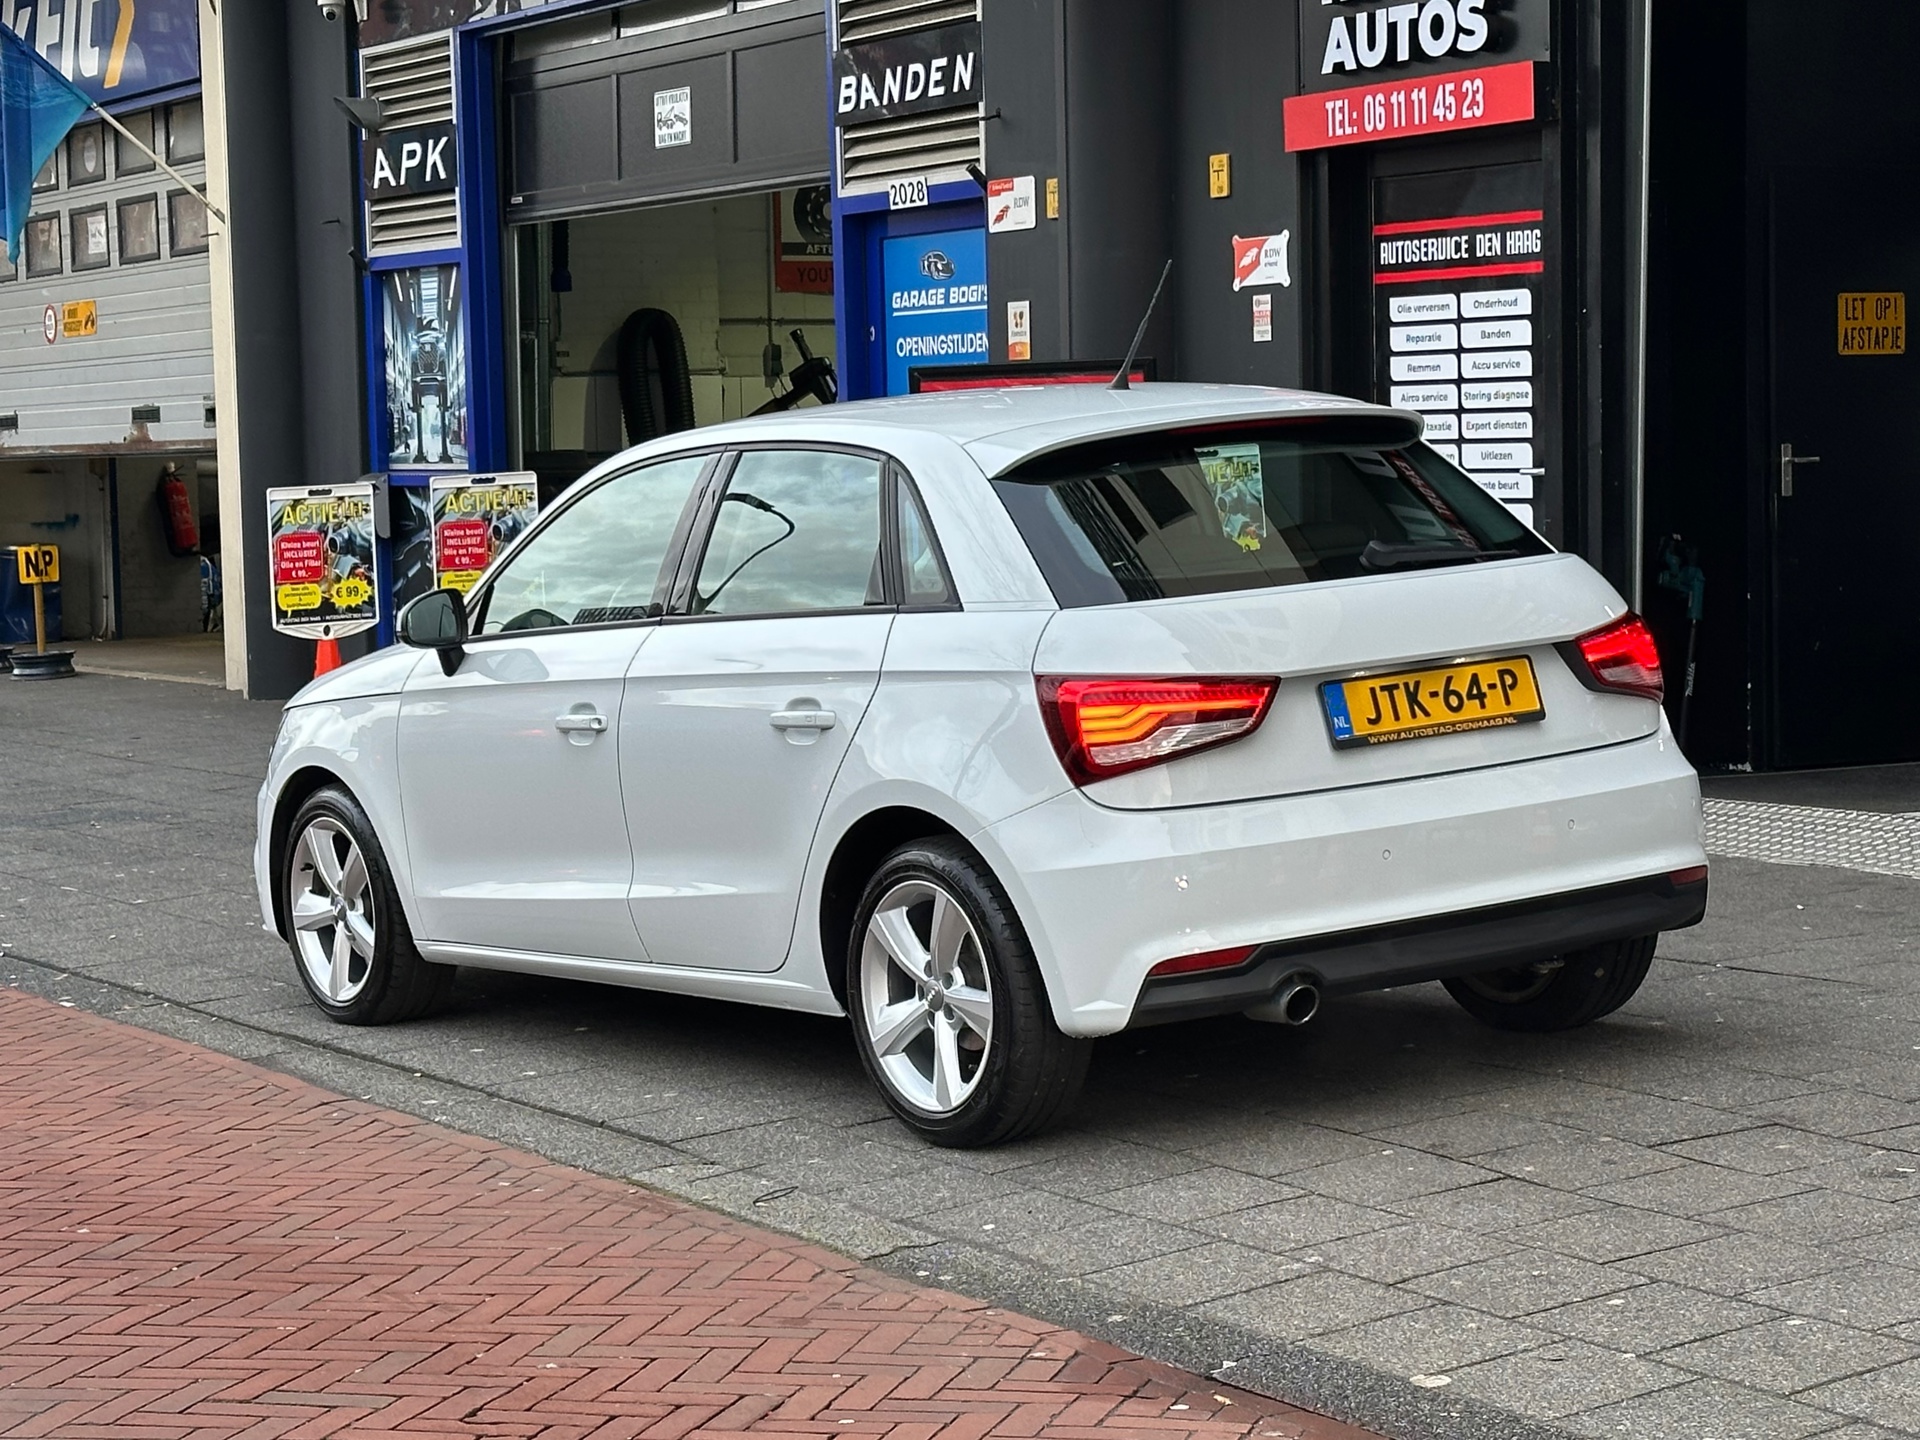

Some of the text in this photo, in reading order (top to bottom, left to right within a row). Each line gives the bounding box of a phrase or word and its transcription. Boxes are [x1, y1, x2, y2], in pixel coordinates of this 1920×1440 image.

[1321, 0, 1488, 74] AUTOS
[838, 52, 974, 113] BANDEN
[1325, 78, 1484, 137] TEL: 06 11 11 45 23
[373, 136, 449, 189] APK
[890, 181, 925, 206] 2028
[1013, 196, 1030, 209] RDW
[1264, 248, 1281, 258] RDW
[1380, 229, 1542, 265] AUTOSERVICE DEN HAAG
[892, 288, 946, 309] GARAGE
[1473, 298, 1518, 310] Onderhoud
[1397, 303, 1450, 314] Olie verversen
[1845, 298, 1898, 321] LET OP!
[1406, 332, 1442, 345] Reparatie
[1480, 329, 1511, 340] Banden
[1842, 326, 1902, 350] AFSTAPJE
[896, 332, 989, 357] OPENINGSTIJDEN
[1407, 363, 1441, 374] Remmen
[1471, 358, 1521, 371] Accu service
[1421, 392, 1448, 402] service
[1463, 390, 1529, 403] Storing diagnose
[1426, 421, 1452, 432] taxatie
[1466, 420, 1528, 433] Export diensten
[1480, 451, 1513, 461] Uitlezen
[1498, 480, 1520, 490] beurt
[336, 585, 369, 599] € 99,-
[1366, 668, 1518, 726] JTK-64-P
[1334, 716, 1349, 729] NL
[1368, 715, 1518, 744] WWW.AUTOSTAD-DENHAAG.NL
